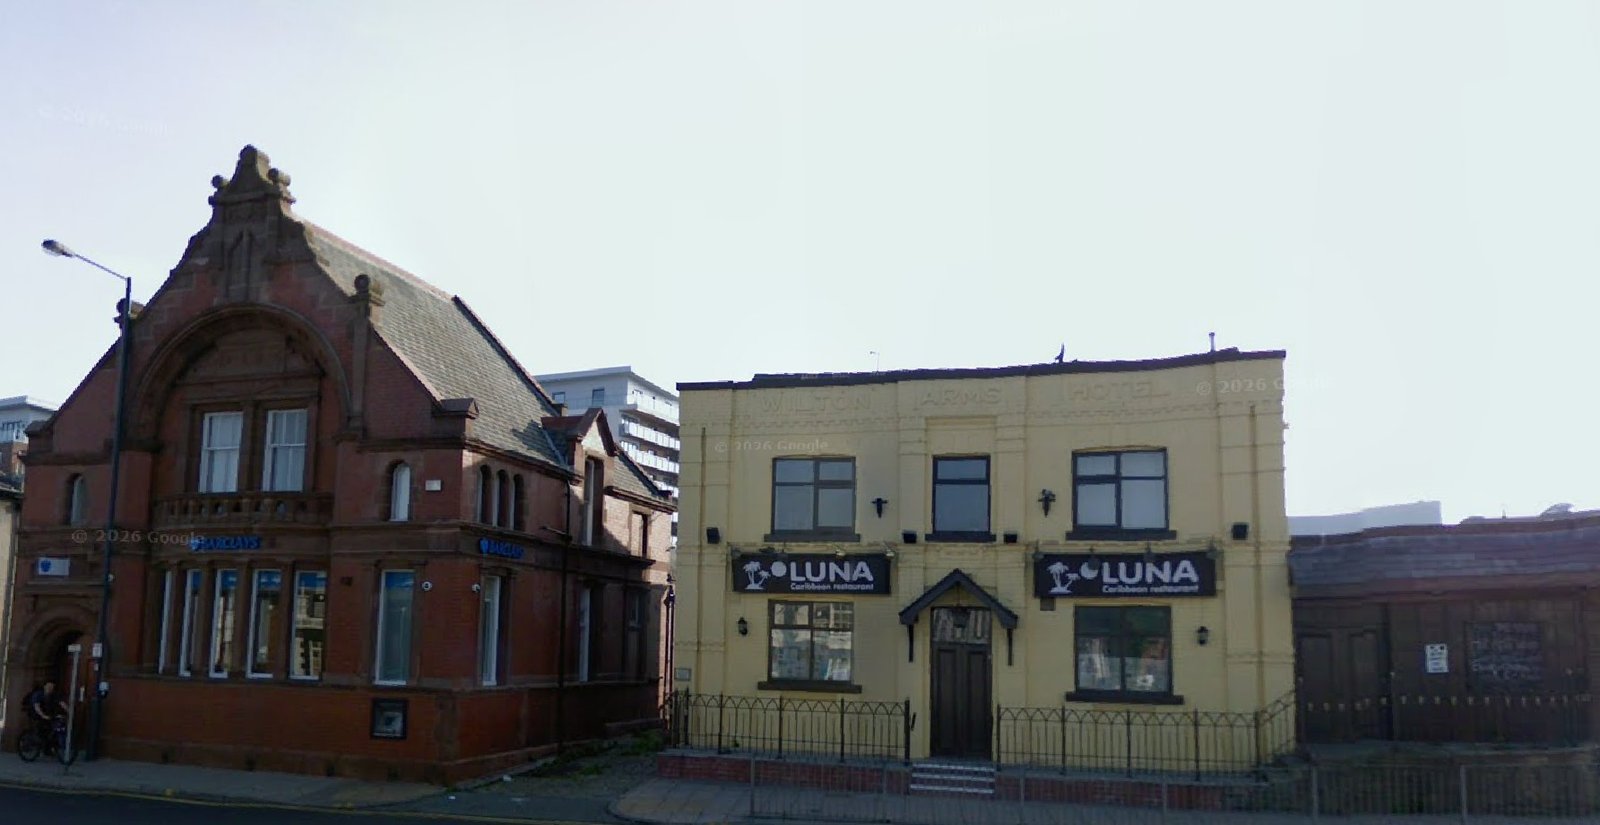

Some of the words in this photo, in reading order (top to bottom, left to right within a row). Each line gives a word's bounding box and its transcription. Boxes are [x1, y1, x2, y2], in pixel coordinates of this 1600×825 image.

[759, 393, 874, 413] WILTON
[919, 388, 1002, 407] ARMS
[1070, 380, 1171, 401] HOTEL
[790, 560, 875, 583] LUNA
[1102, 559, 1200, 585] LUNA
[790, 583, 831, 591] Caribbean
[833, 582, 875, 591] restaurant
[1102, 585, 1148, 594] Caribbean
[1150, 584, 1200, 594] restaurant
